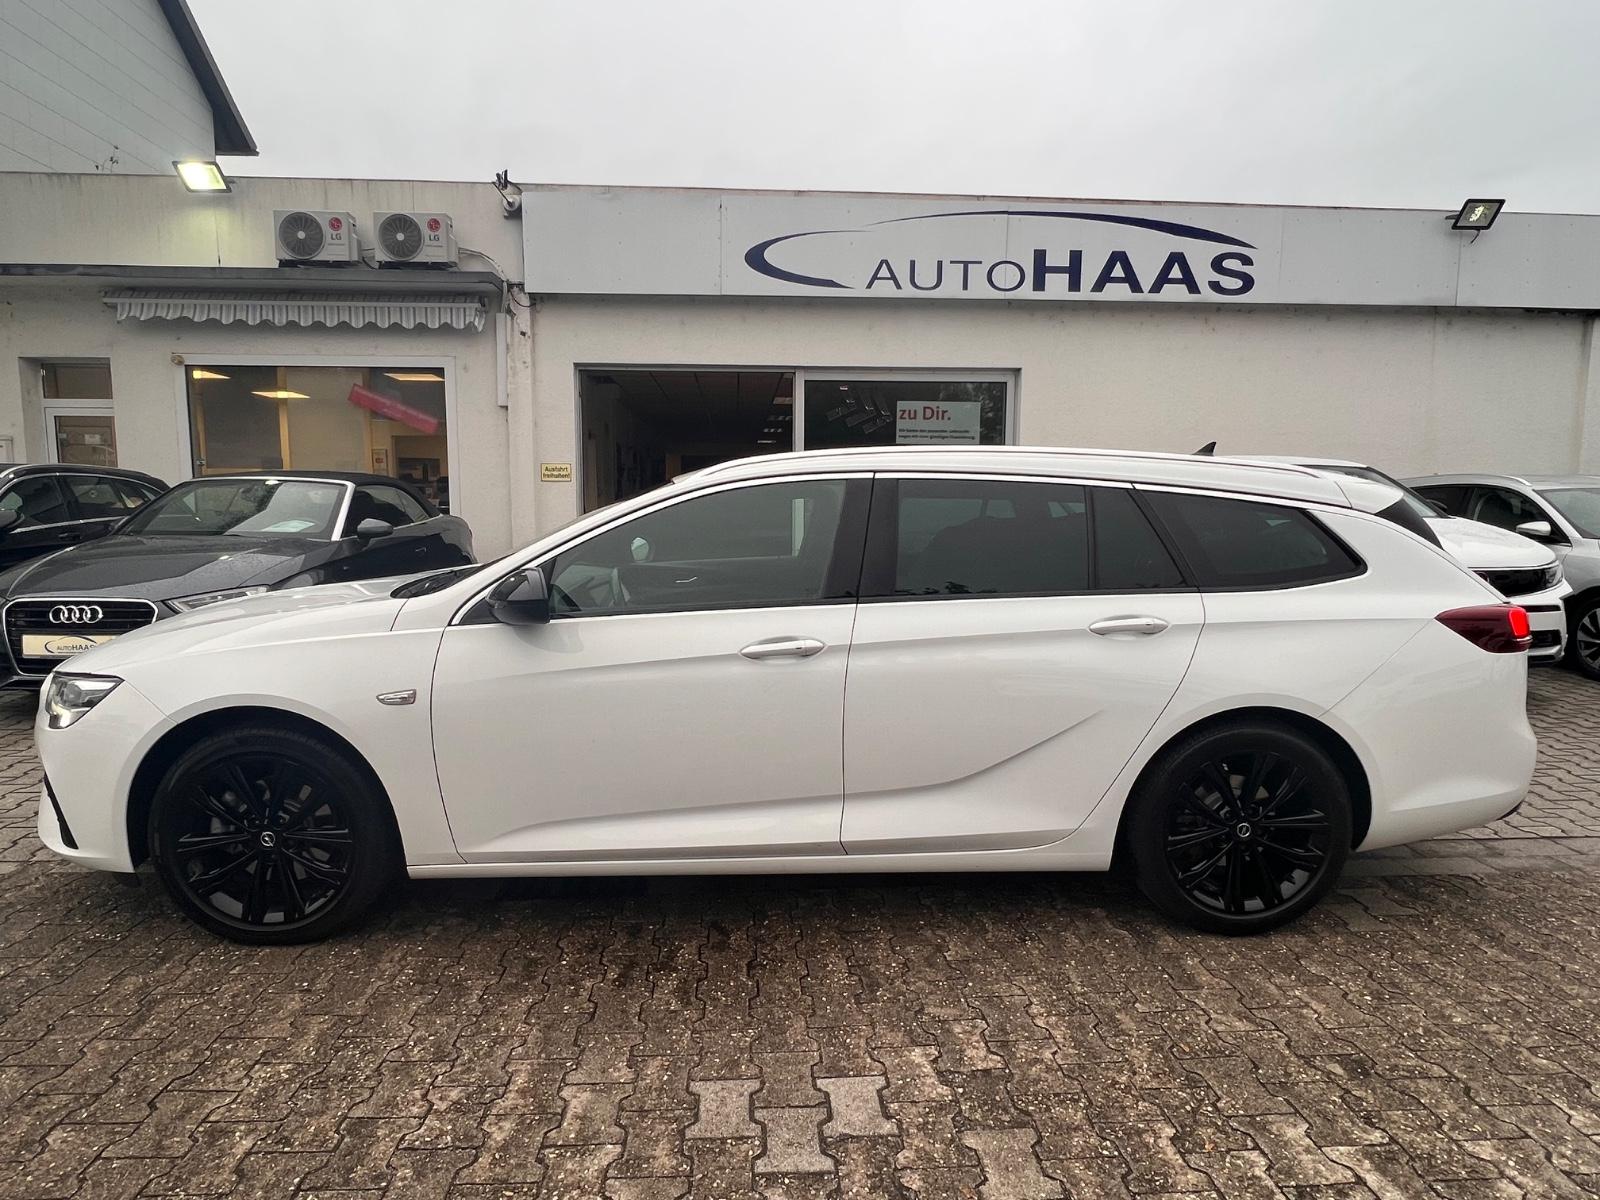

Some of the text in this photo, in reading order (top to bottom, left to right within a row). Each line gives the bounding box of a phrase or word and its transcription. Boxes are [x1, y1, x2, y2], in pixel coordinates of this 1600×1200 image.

[331, 233, 342, 241] LG
[429, 234, 440, 242] LG
[899, 406, 951, 421] zu Dir.
